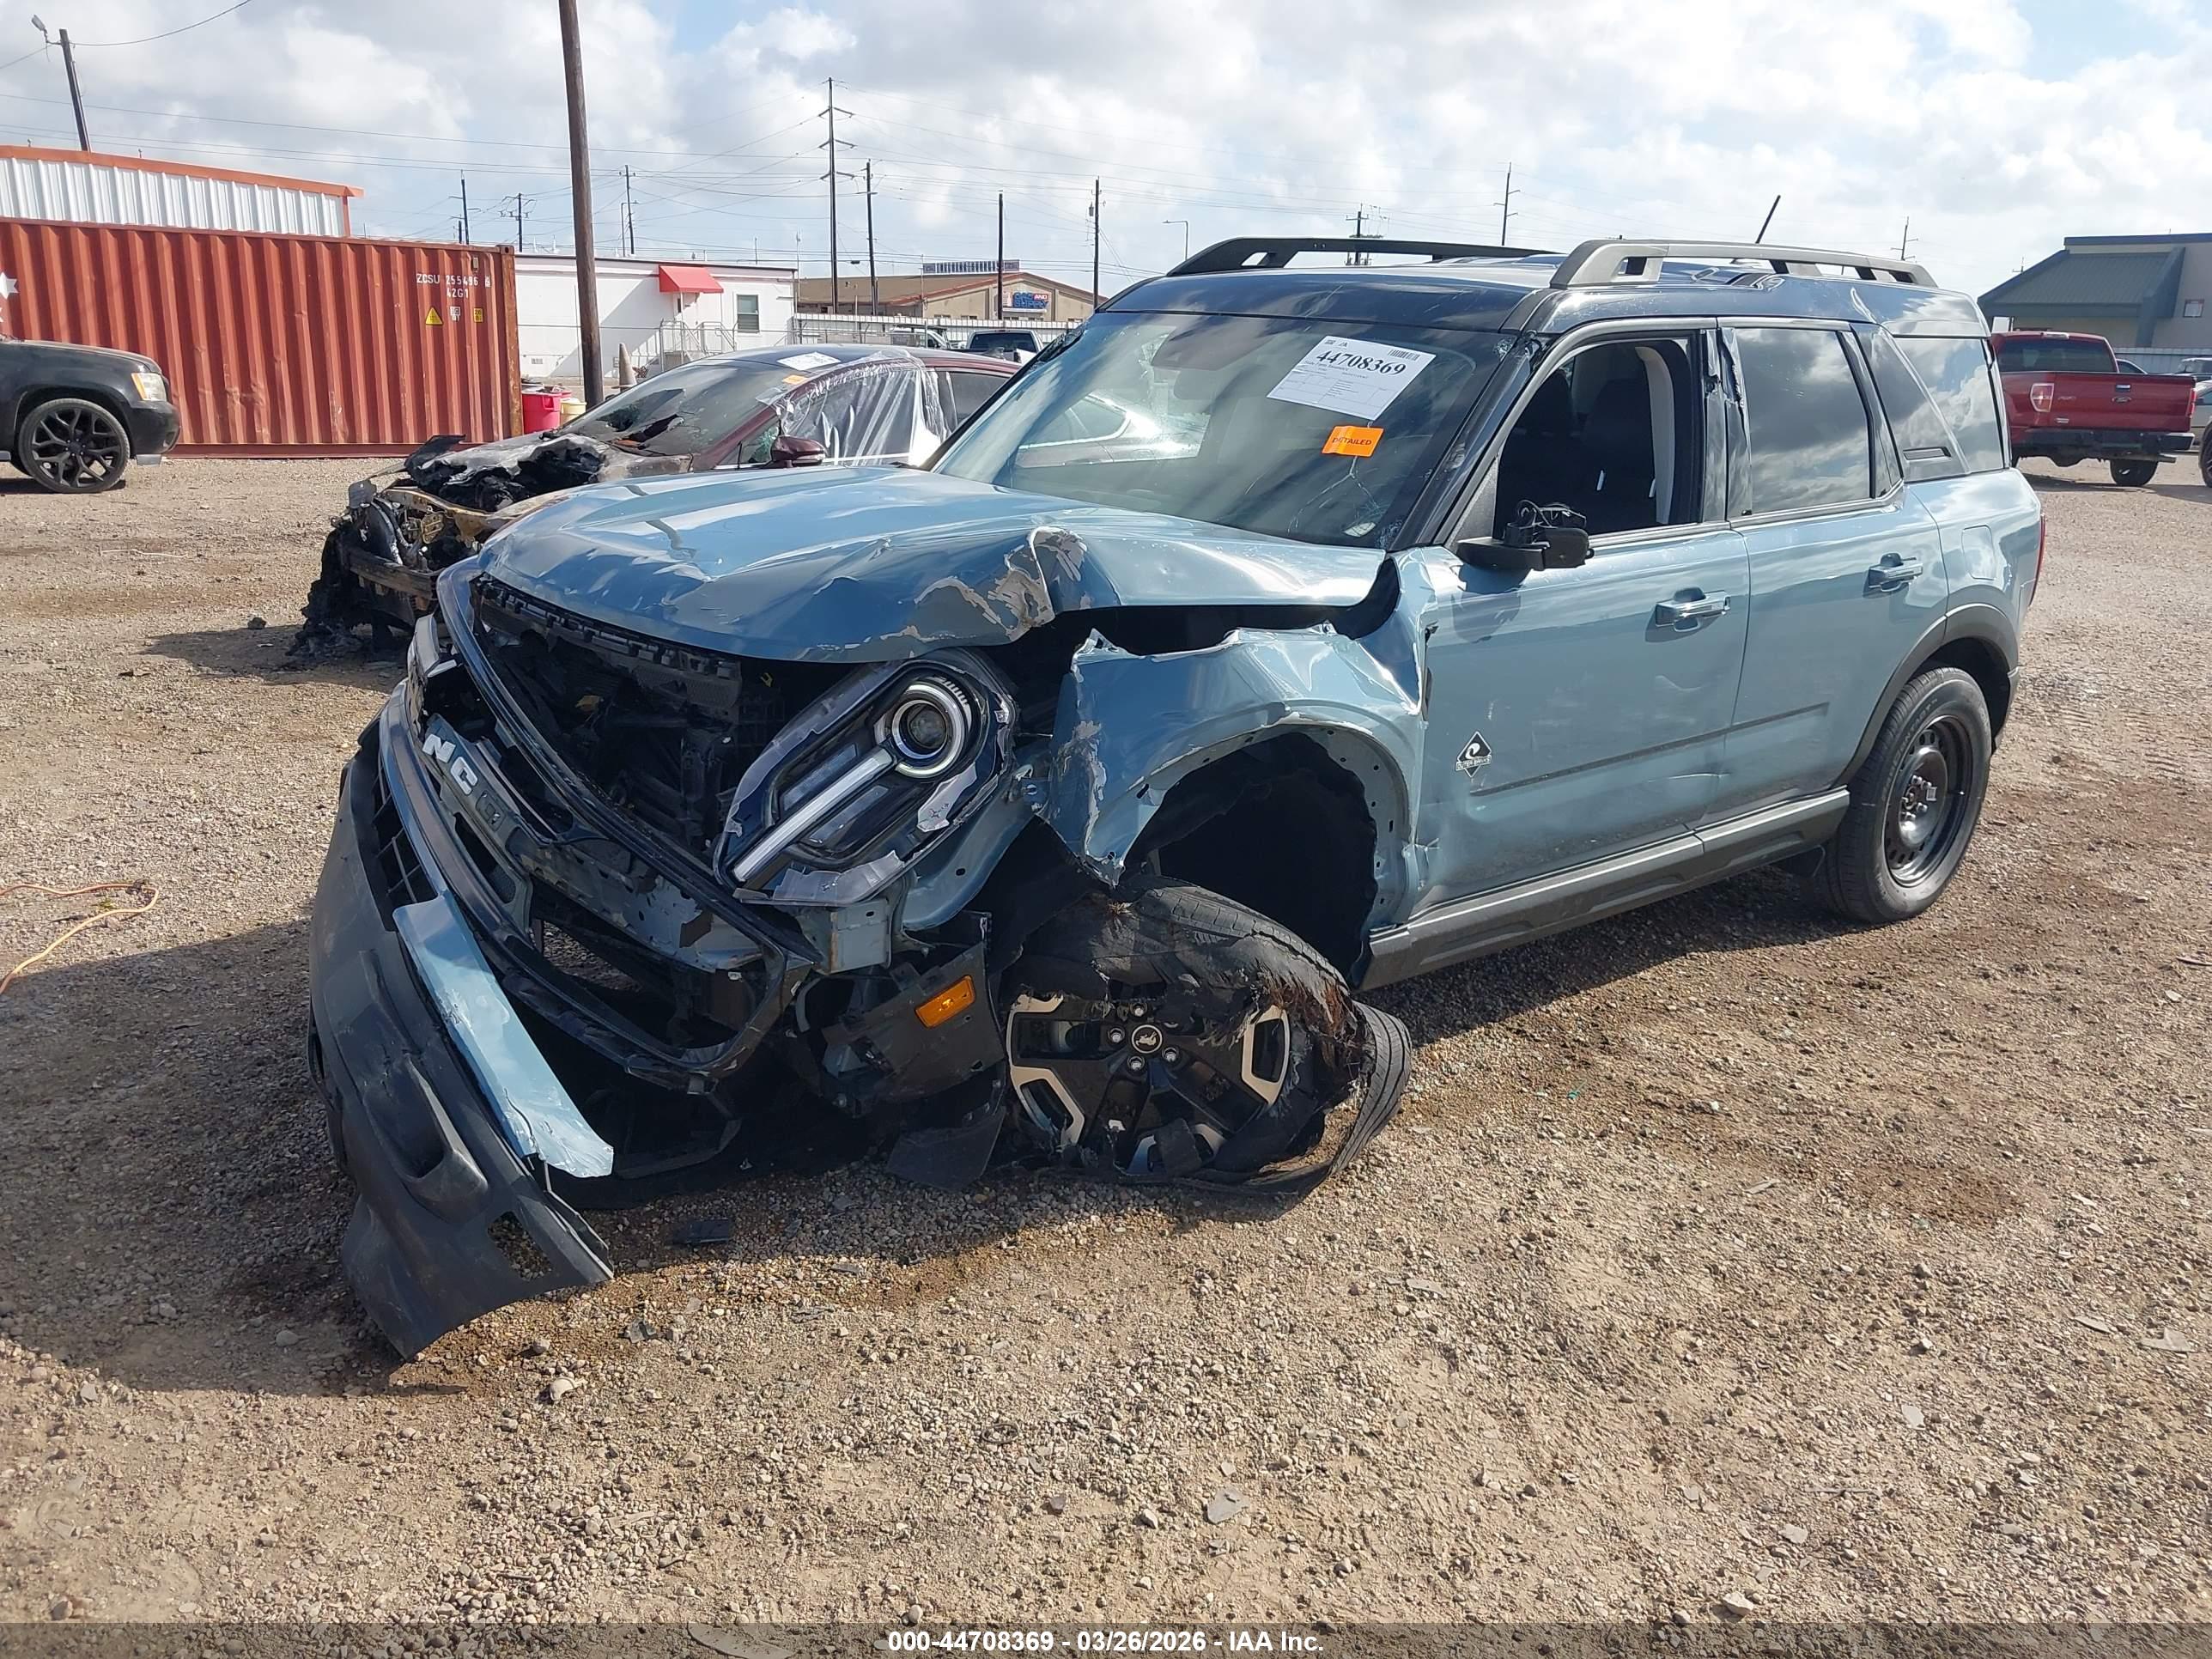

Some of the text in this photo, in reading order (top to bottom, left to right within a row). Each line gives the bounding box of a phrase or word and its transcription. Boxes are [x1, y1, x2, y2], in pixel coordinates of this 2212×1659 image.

[416, 273, 440, 284] ZCSU
[446, 275, 478, 286] 255496
[447, 288, 469, 299] 42G1
[1316, 350, 1407, 375] 44708369
[1332, 437, 1372, 446] DETAILED
